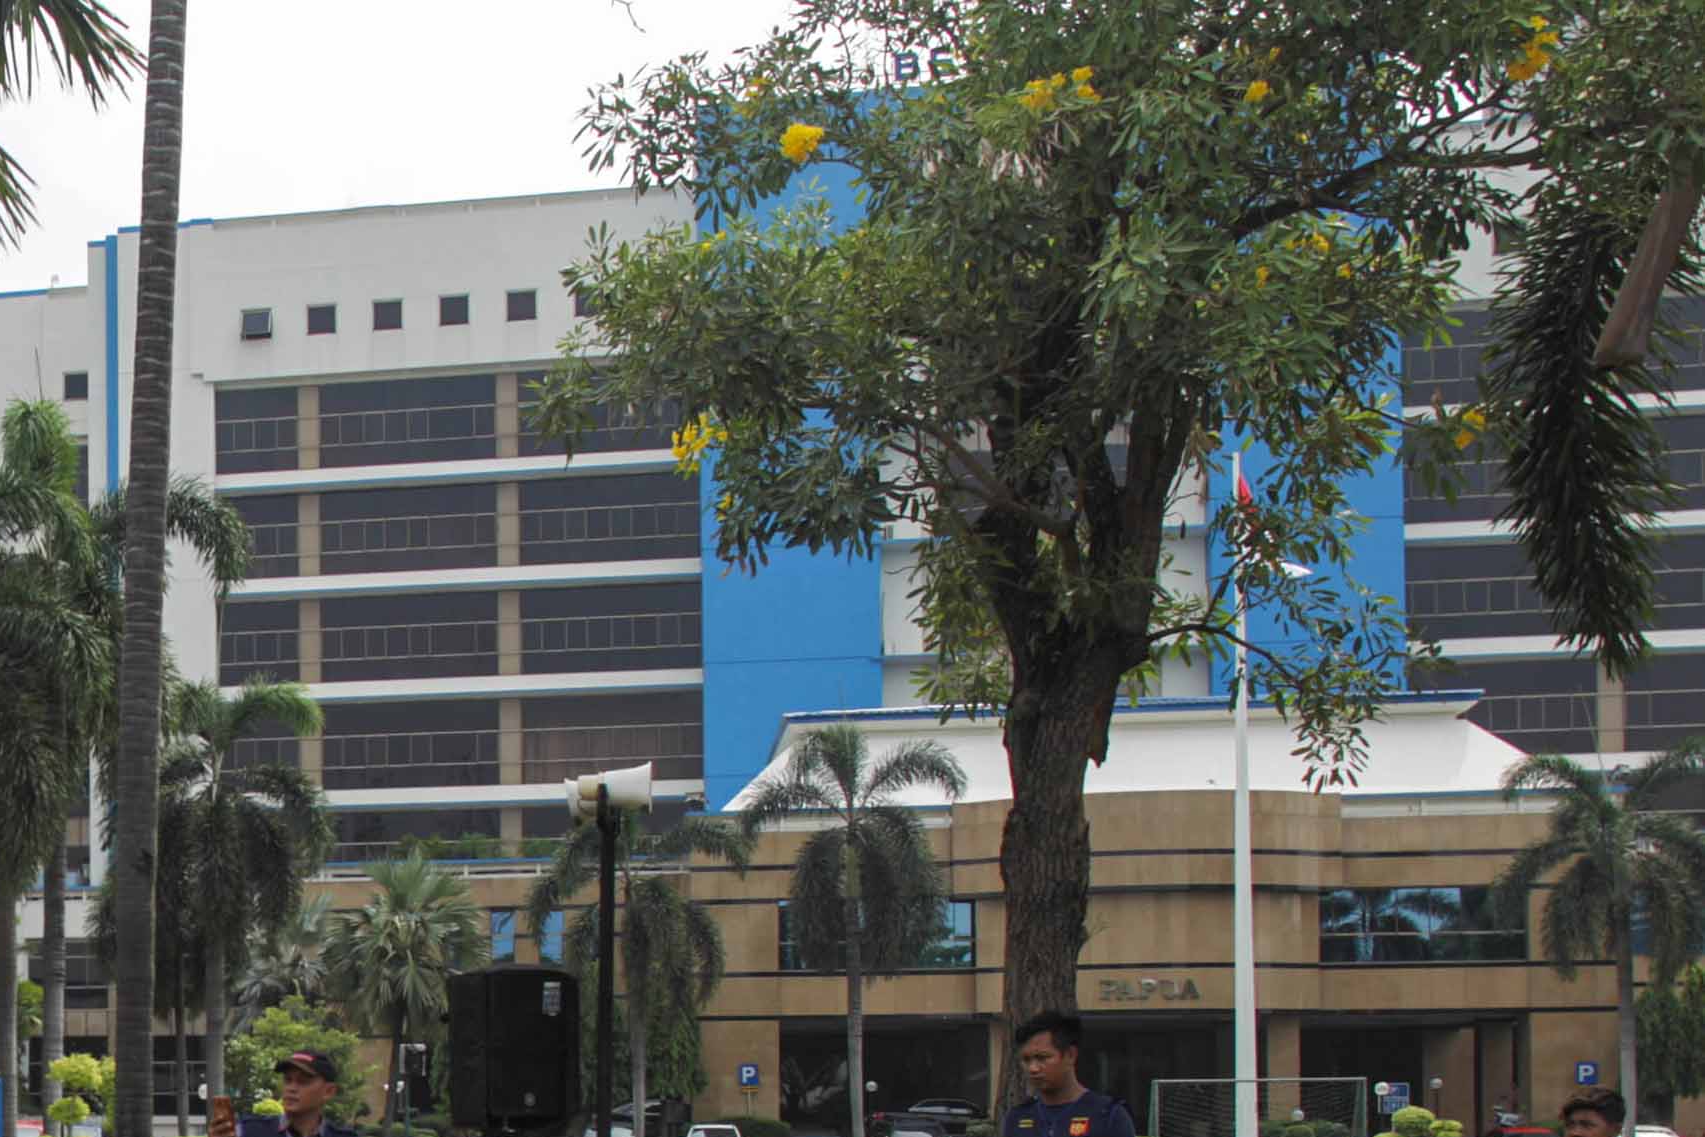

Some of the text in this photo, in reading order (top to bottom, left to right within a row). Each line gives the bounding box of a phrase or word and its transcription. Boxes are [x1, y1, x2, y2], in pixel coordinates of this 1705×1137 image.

[1098, 978, 1201, 1001] PAPUA
[741, 1065, 756, 1085] P
[1578, 1064, 1595, 1083] P
